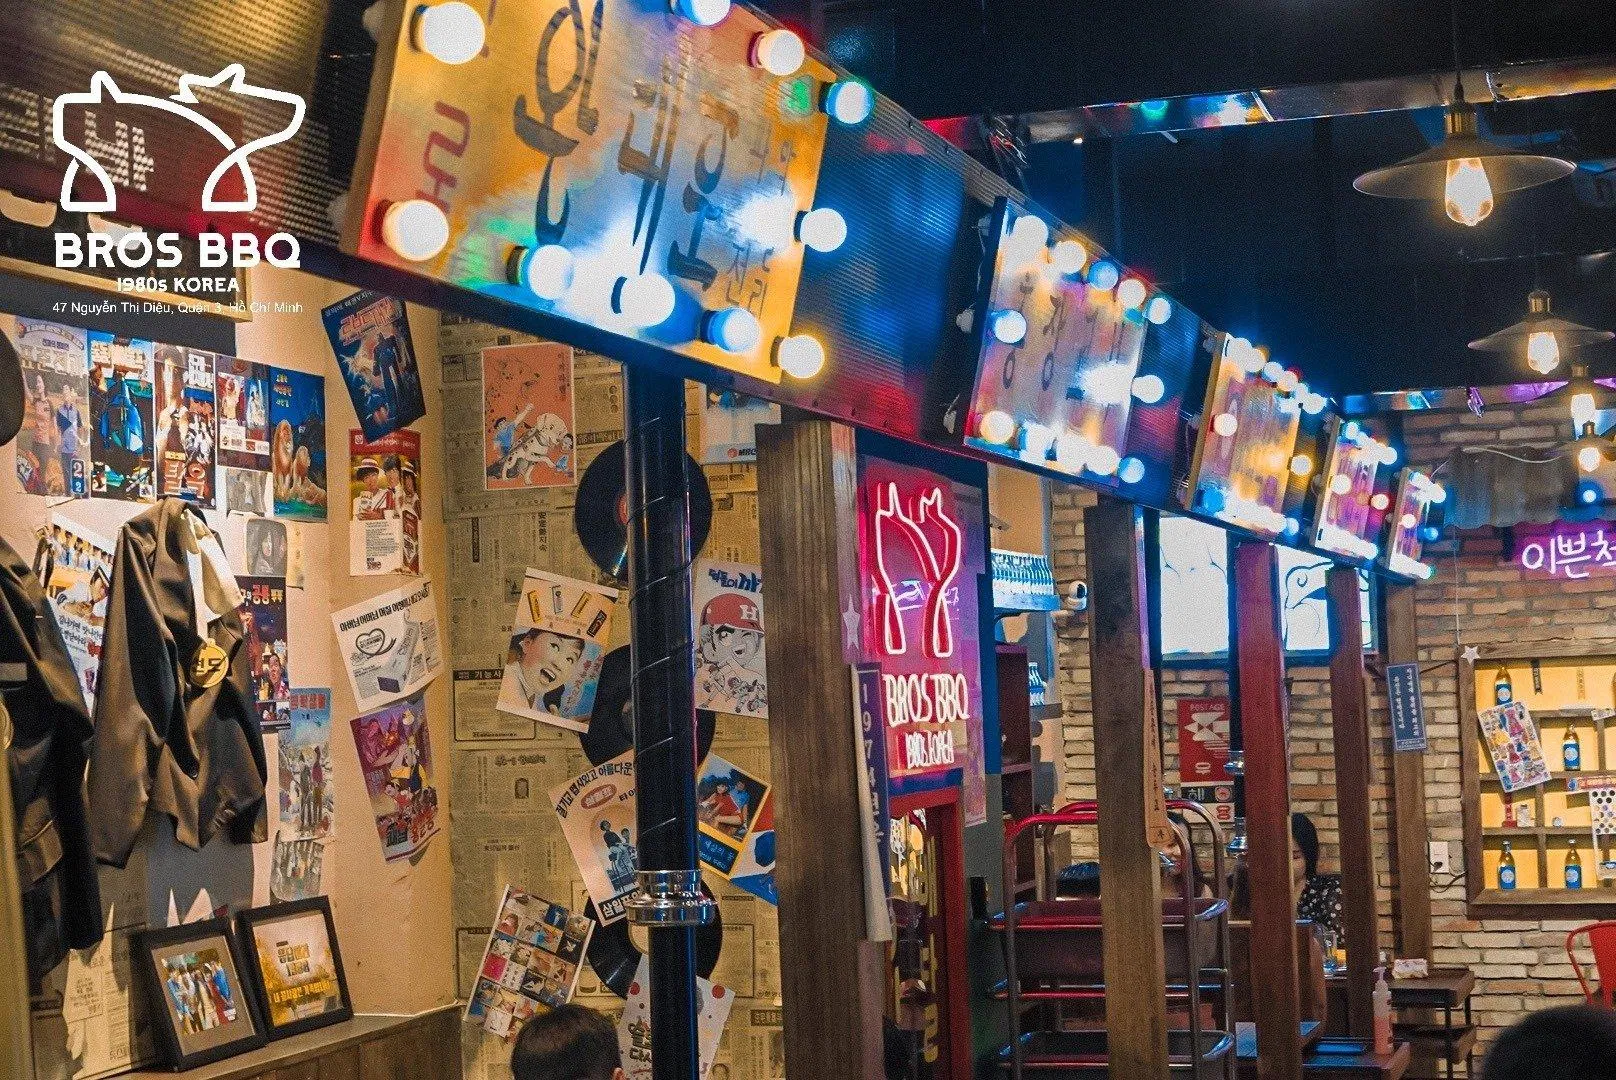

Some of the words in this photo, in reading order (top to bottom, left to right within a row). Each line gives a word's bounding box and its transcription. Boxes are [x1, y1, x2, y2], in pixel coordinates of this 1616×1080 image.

[882, 673, 932, 727] BROS
[930, 672, 971, 724] BBQ
[1189, 703, 1226, 712] POSTAGE
